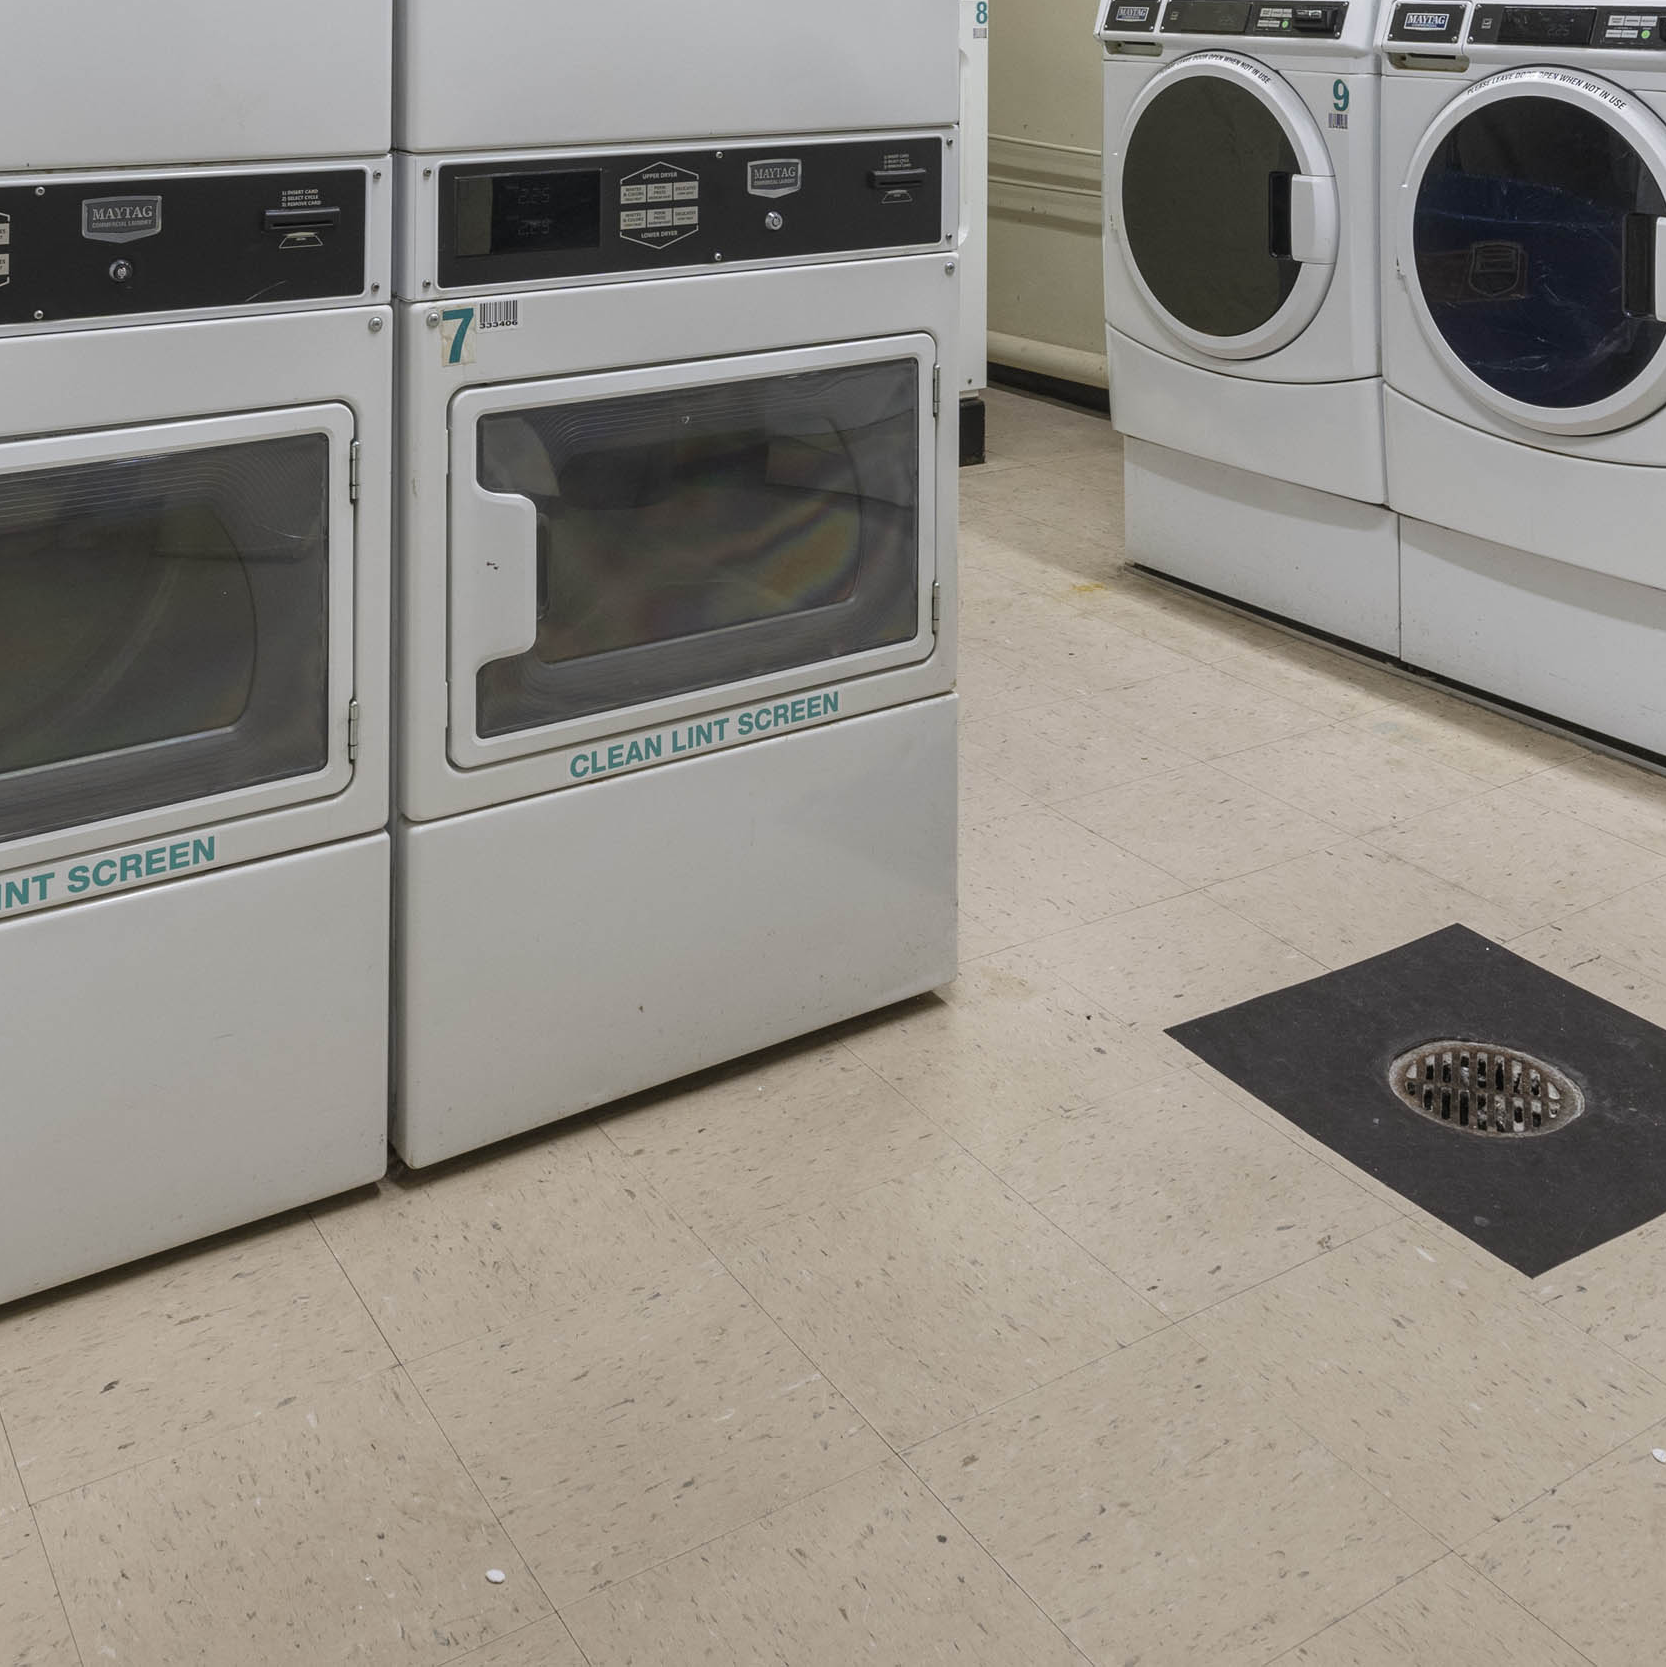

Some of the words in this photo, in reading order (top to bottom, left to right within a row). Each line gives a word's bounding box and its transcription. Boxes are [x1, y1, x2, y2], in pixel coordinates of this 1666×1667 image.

[976, 2, 987, 24] 8
[1408, 15, 1445, 23] MAYTAG
[1333, 79, 1349, 111] 9
[754, 167, 796, 179] MAYTAG
[93, 206, 152, 220] MAYTAG
[443, 308, 474, 363] 7
[570, 734, 661, 778] CLEAN
[672, 718, 729, 753] LINT
[738, 692, 838, 735] SCREEN
[67, 836, 215, 893] SCREEN
